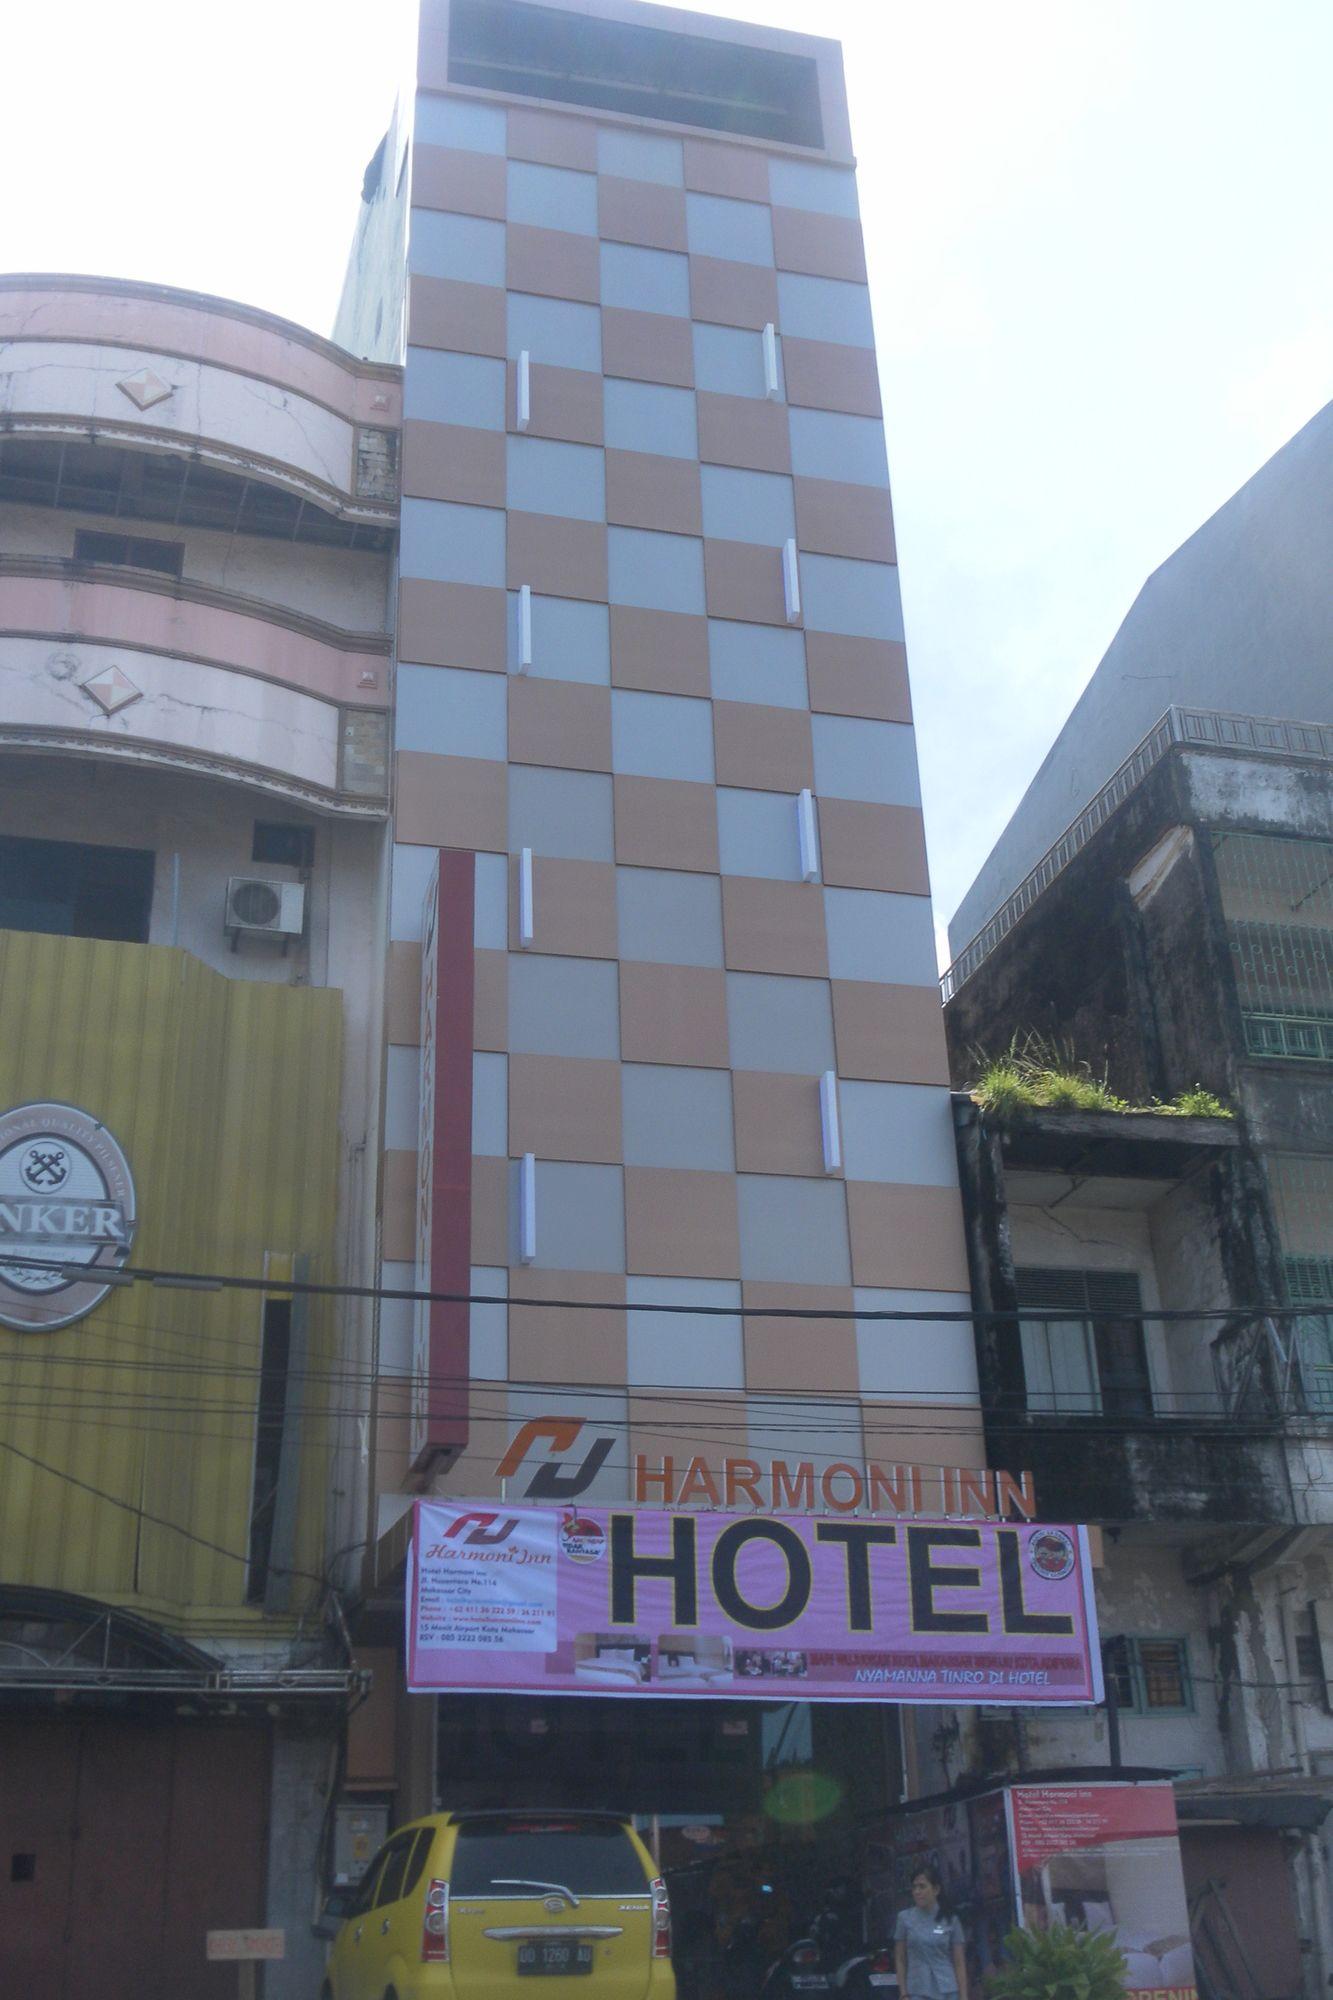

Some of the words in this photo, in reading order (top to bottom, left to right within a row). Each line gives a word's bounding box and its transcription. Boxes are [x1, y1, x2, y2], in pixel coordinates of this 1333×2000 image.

[635, 1453, 922, 1514] HARMONI
[942, 1466, 1037, 1519] INN
[425, 1544, 518, 1563] Harmoni
[610, 1511, 1076, 1636] HOTEL
[855, 1669, 936, 1682] NYAMANNA
[941, 1670, 984, 1684] TINRO
[989, 1671, 1004, 1684] DI
[1008, 1672, 1051, 1686] HOTEL
